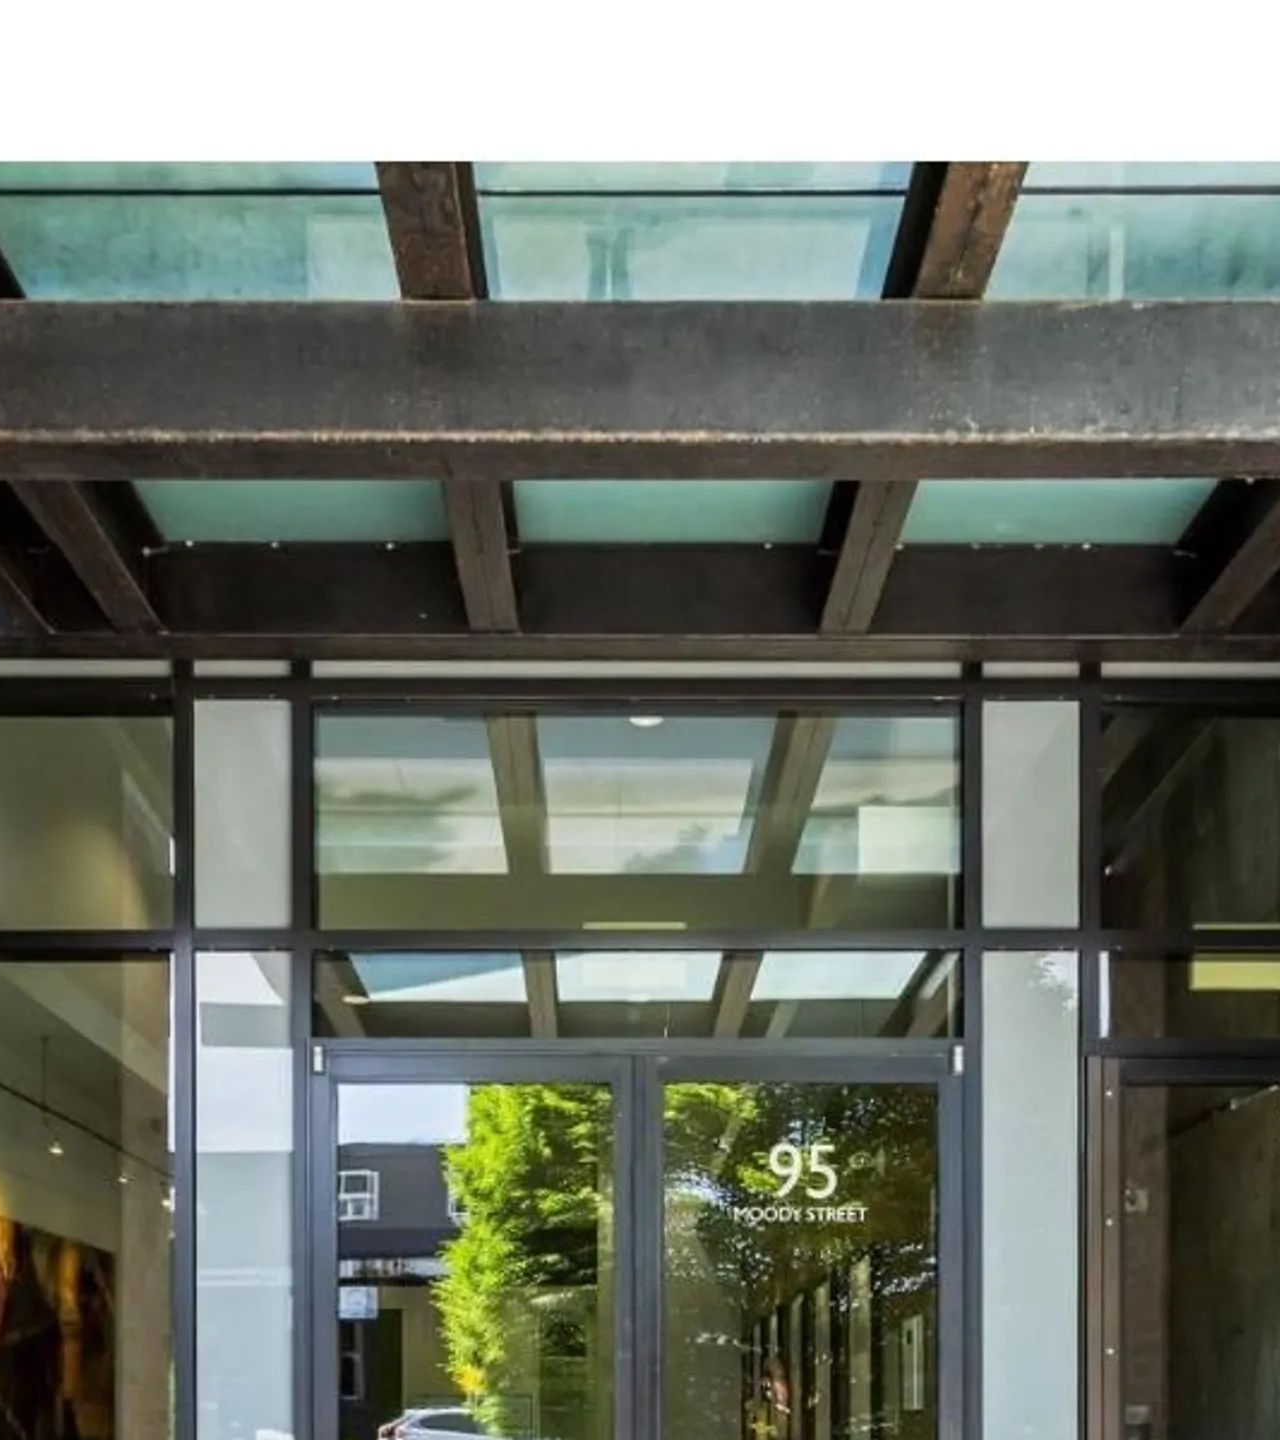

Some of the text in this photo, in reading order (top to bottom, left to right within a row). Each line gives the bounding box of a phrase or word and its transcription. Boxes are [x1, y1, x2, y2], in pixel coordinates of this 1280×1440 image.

[770, 1142, 838, 1199] 95
[732, 1206, 869, 1223] MOODY STREET
